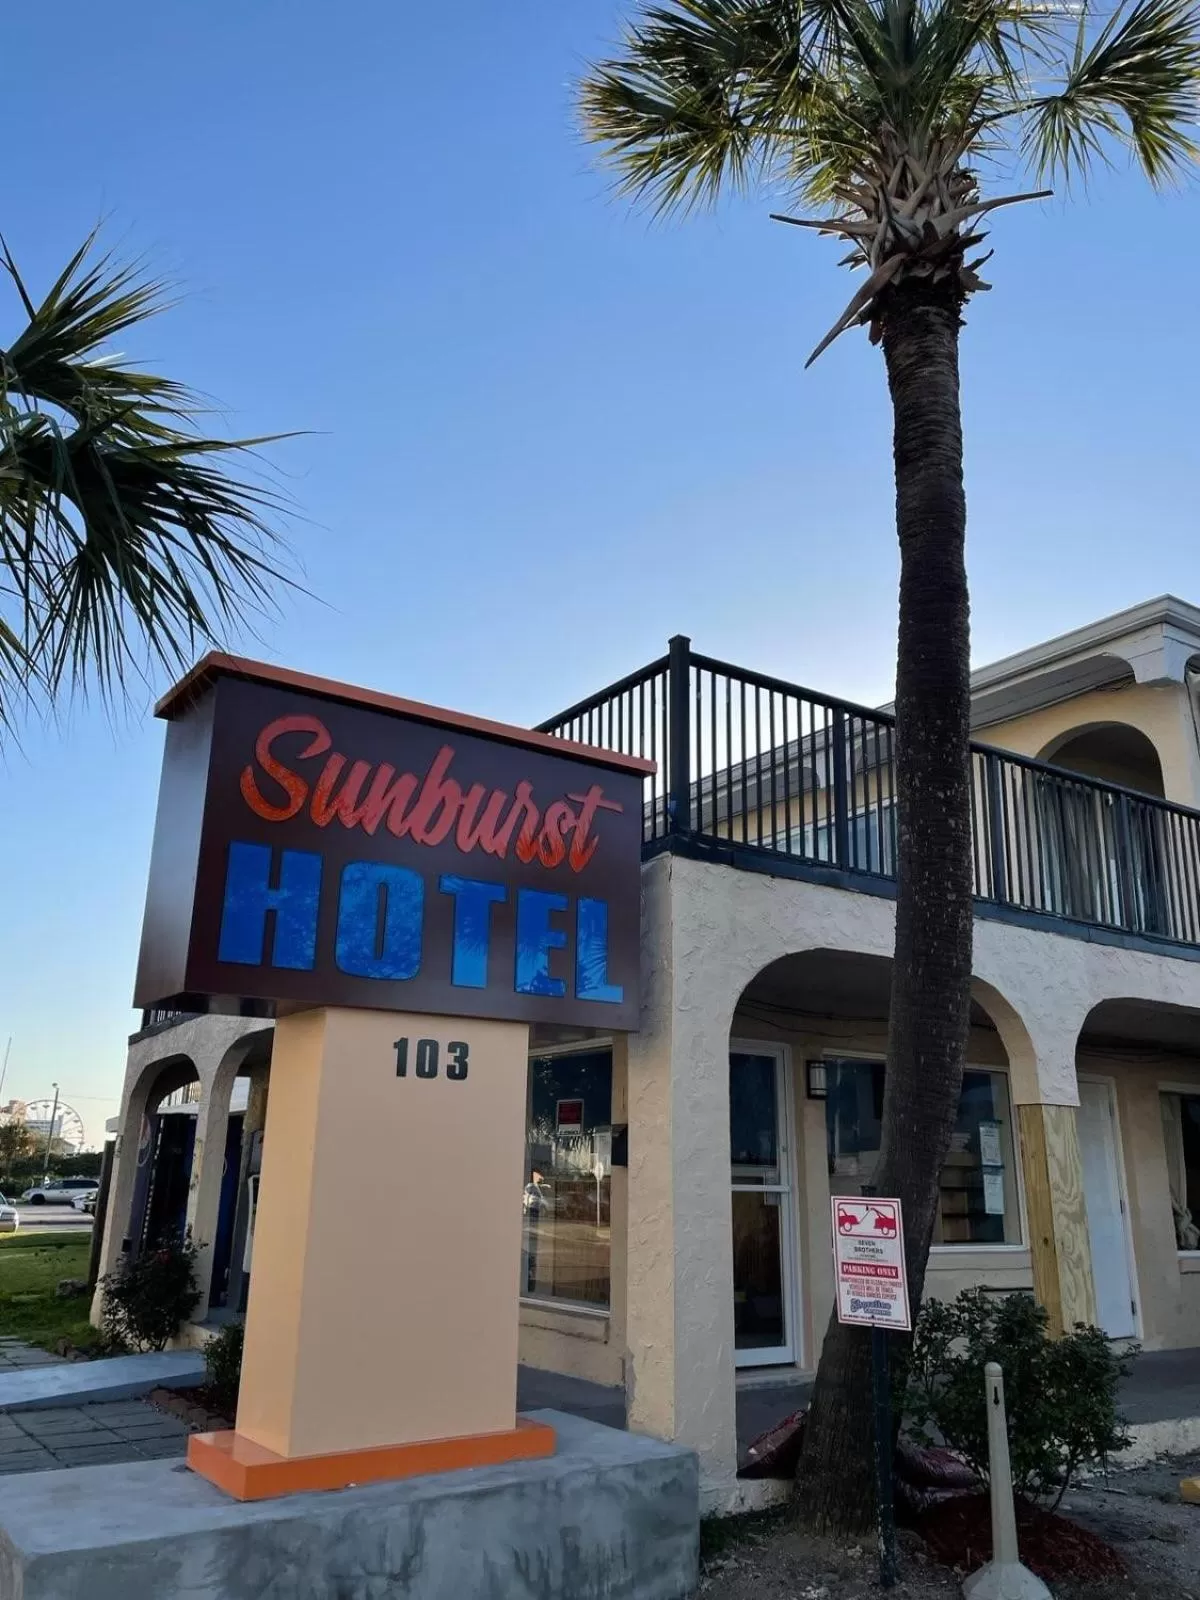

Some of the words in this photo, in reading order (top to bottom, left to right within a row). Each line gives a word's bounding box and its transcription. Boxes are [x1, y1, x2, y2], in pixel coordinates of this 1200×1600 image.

[239, 714, 624, 872] Sunburst
[216, 840, 624, 1004] HOTEL
[393, 1036, 470, 1081] 103
[843, 1264, 876, 1275] PARKING
[877, 1267, 896, 1276] ONLY
[854, 1246, 884, 1254] BROTHERS
